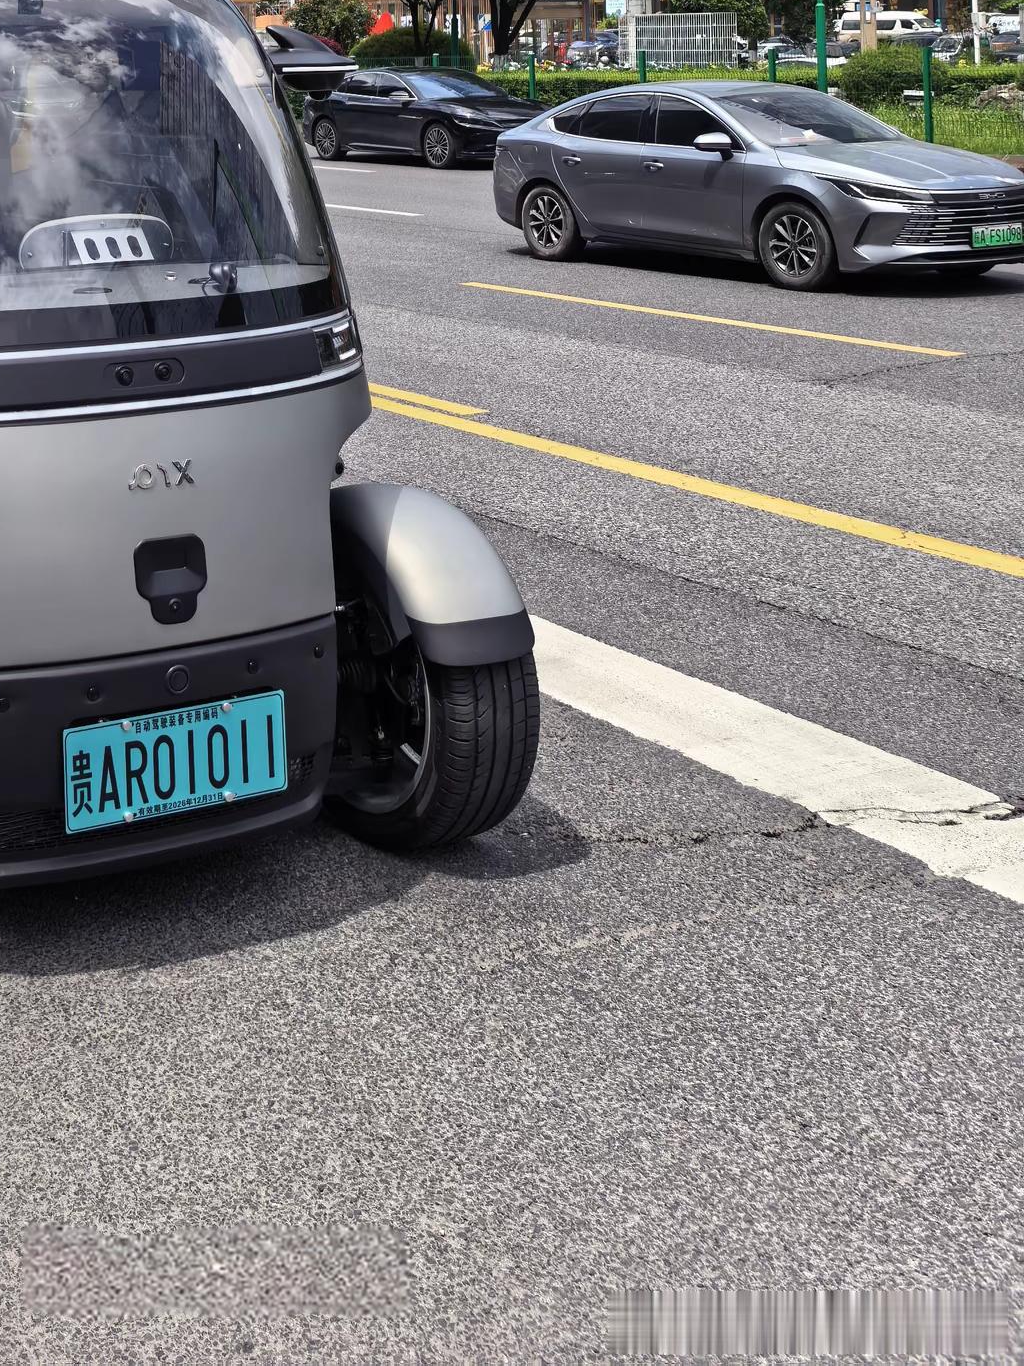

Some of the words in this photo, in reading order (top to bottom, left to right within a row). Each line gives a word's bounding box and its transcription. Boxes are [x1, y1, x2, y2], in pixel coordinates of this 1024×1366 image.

[135, 707, 219, 734] 自动驾驶装备专用编码
